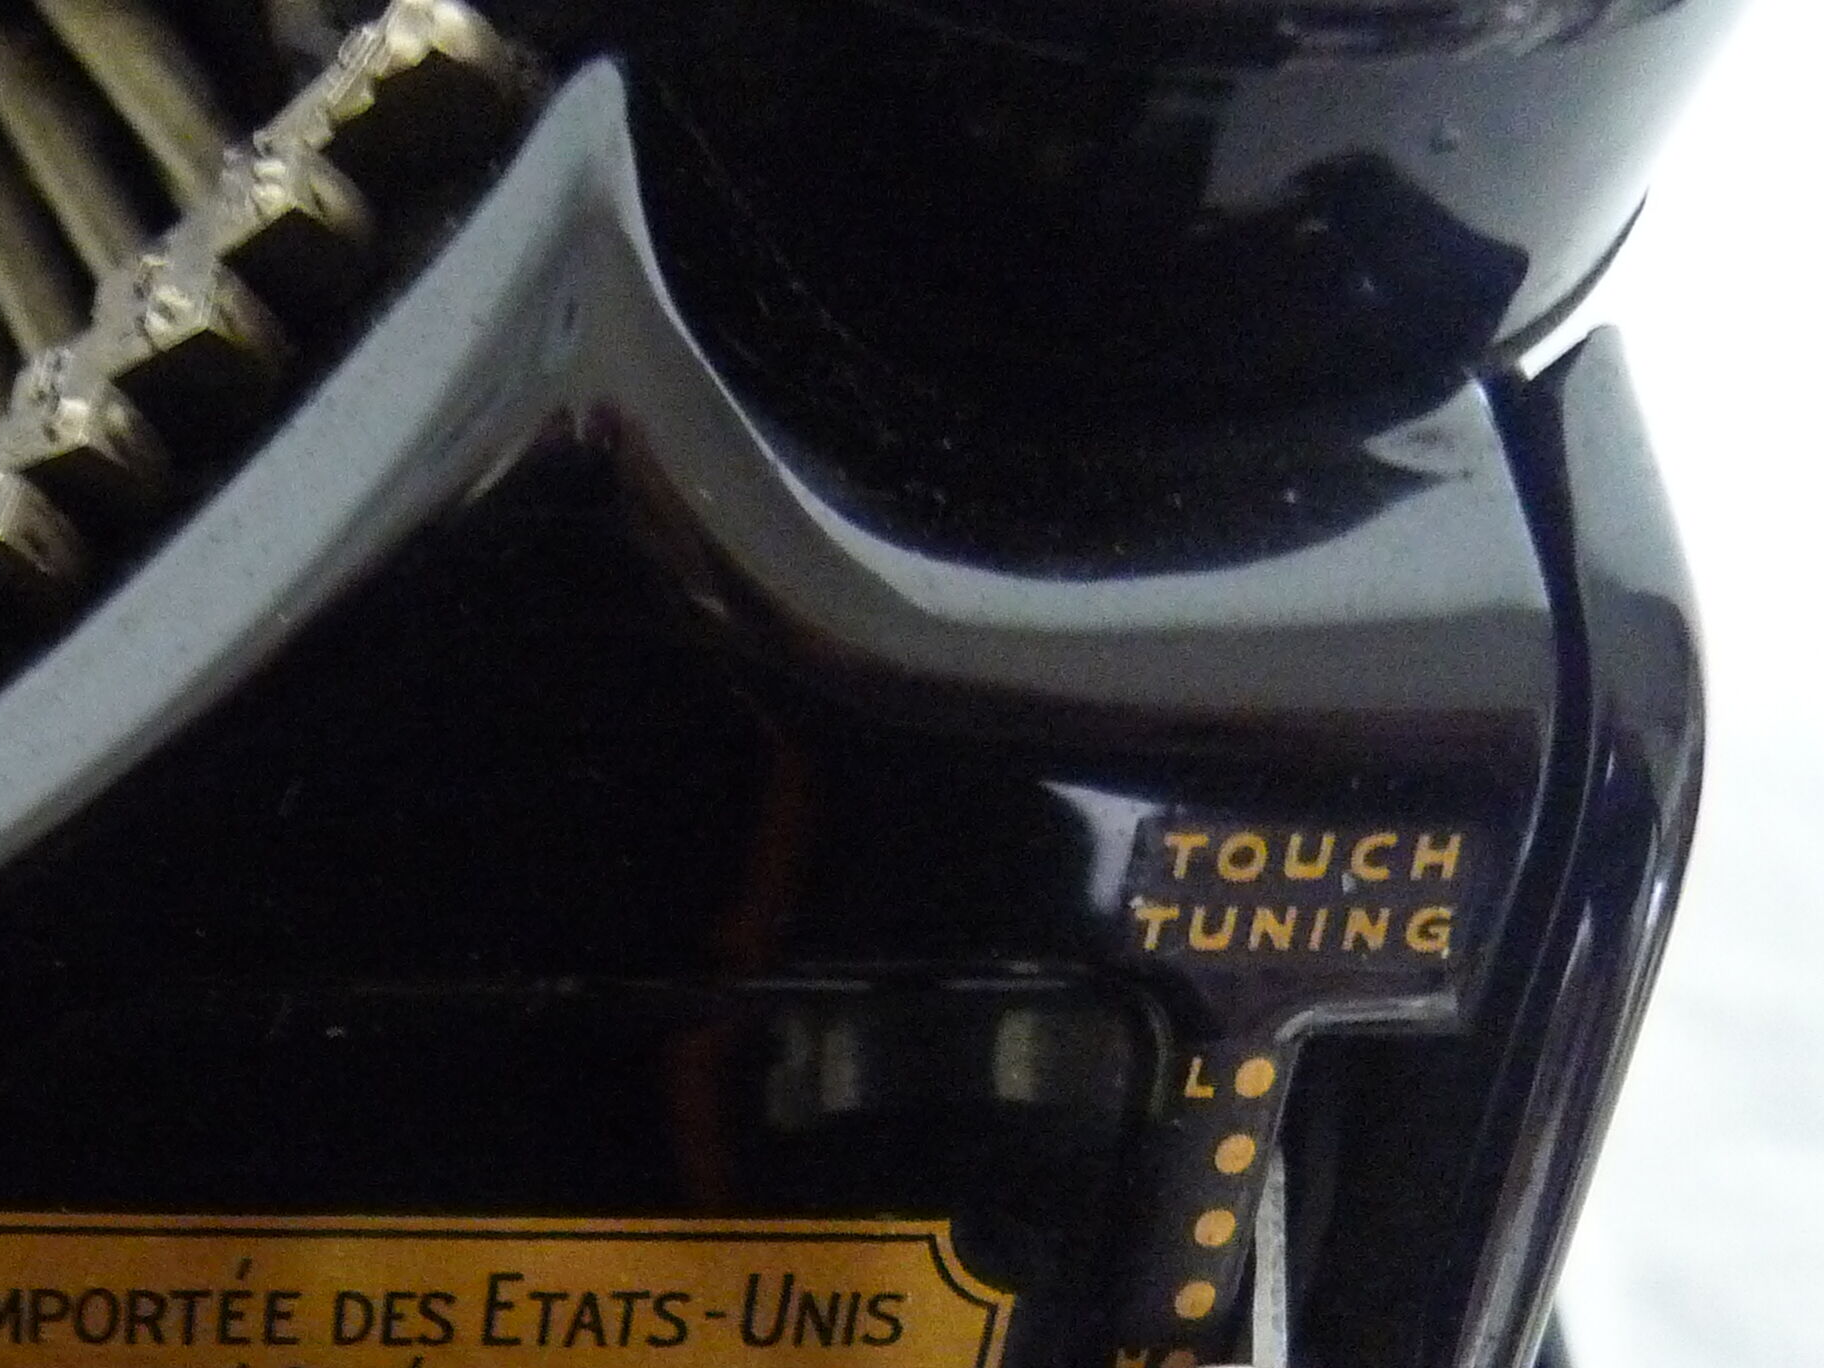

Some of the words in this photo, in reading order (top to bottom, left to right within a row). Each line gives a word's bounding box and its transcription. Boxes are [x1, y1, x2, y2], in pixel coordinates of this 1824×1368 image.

[1164, 831, 1462, 882] TOUCH
[1132, 903, 1456, 955] TUNING
[331, 1289, 458, 1347] DES
